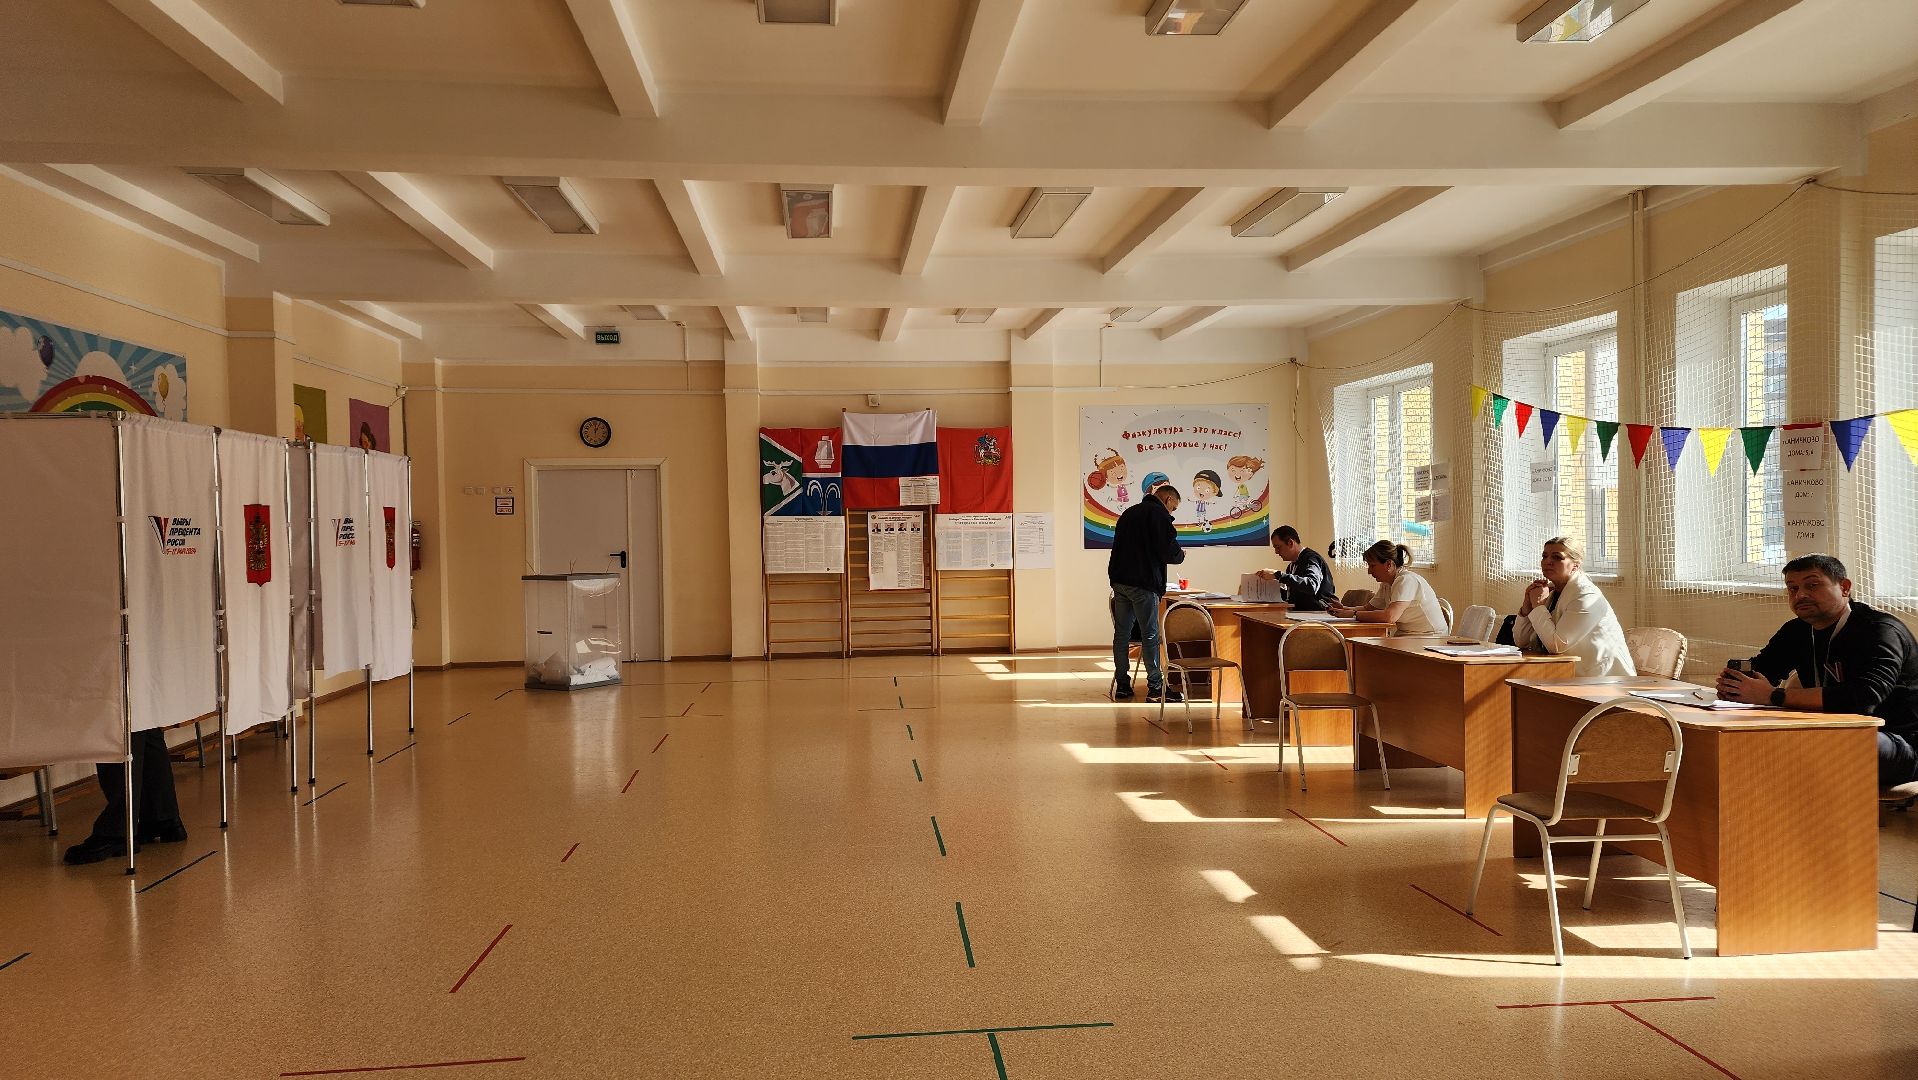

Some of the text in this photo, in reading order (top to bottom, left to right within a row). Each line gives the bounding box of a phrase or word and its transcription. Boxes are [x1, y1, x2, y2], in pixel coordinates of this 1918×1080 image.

[597, 334, 618, 342] ВЫХОД
[1121, 426, 1184, 440] Физкультура
[1192, 426, 1208, 434] это
[1211, 428, 1242, 440] класс!
[1157, 441, 1199, 450] здоровые
[1202, 442, 1207, 450] у
[1209, 442, 1228, 452] нас!
